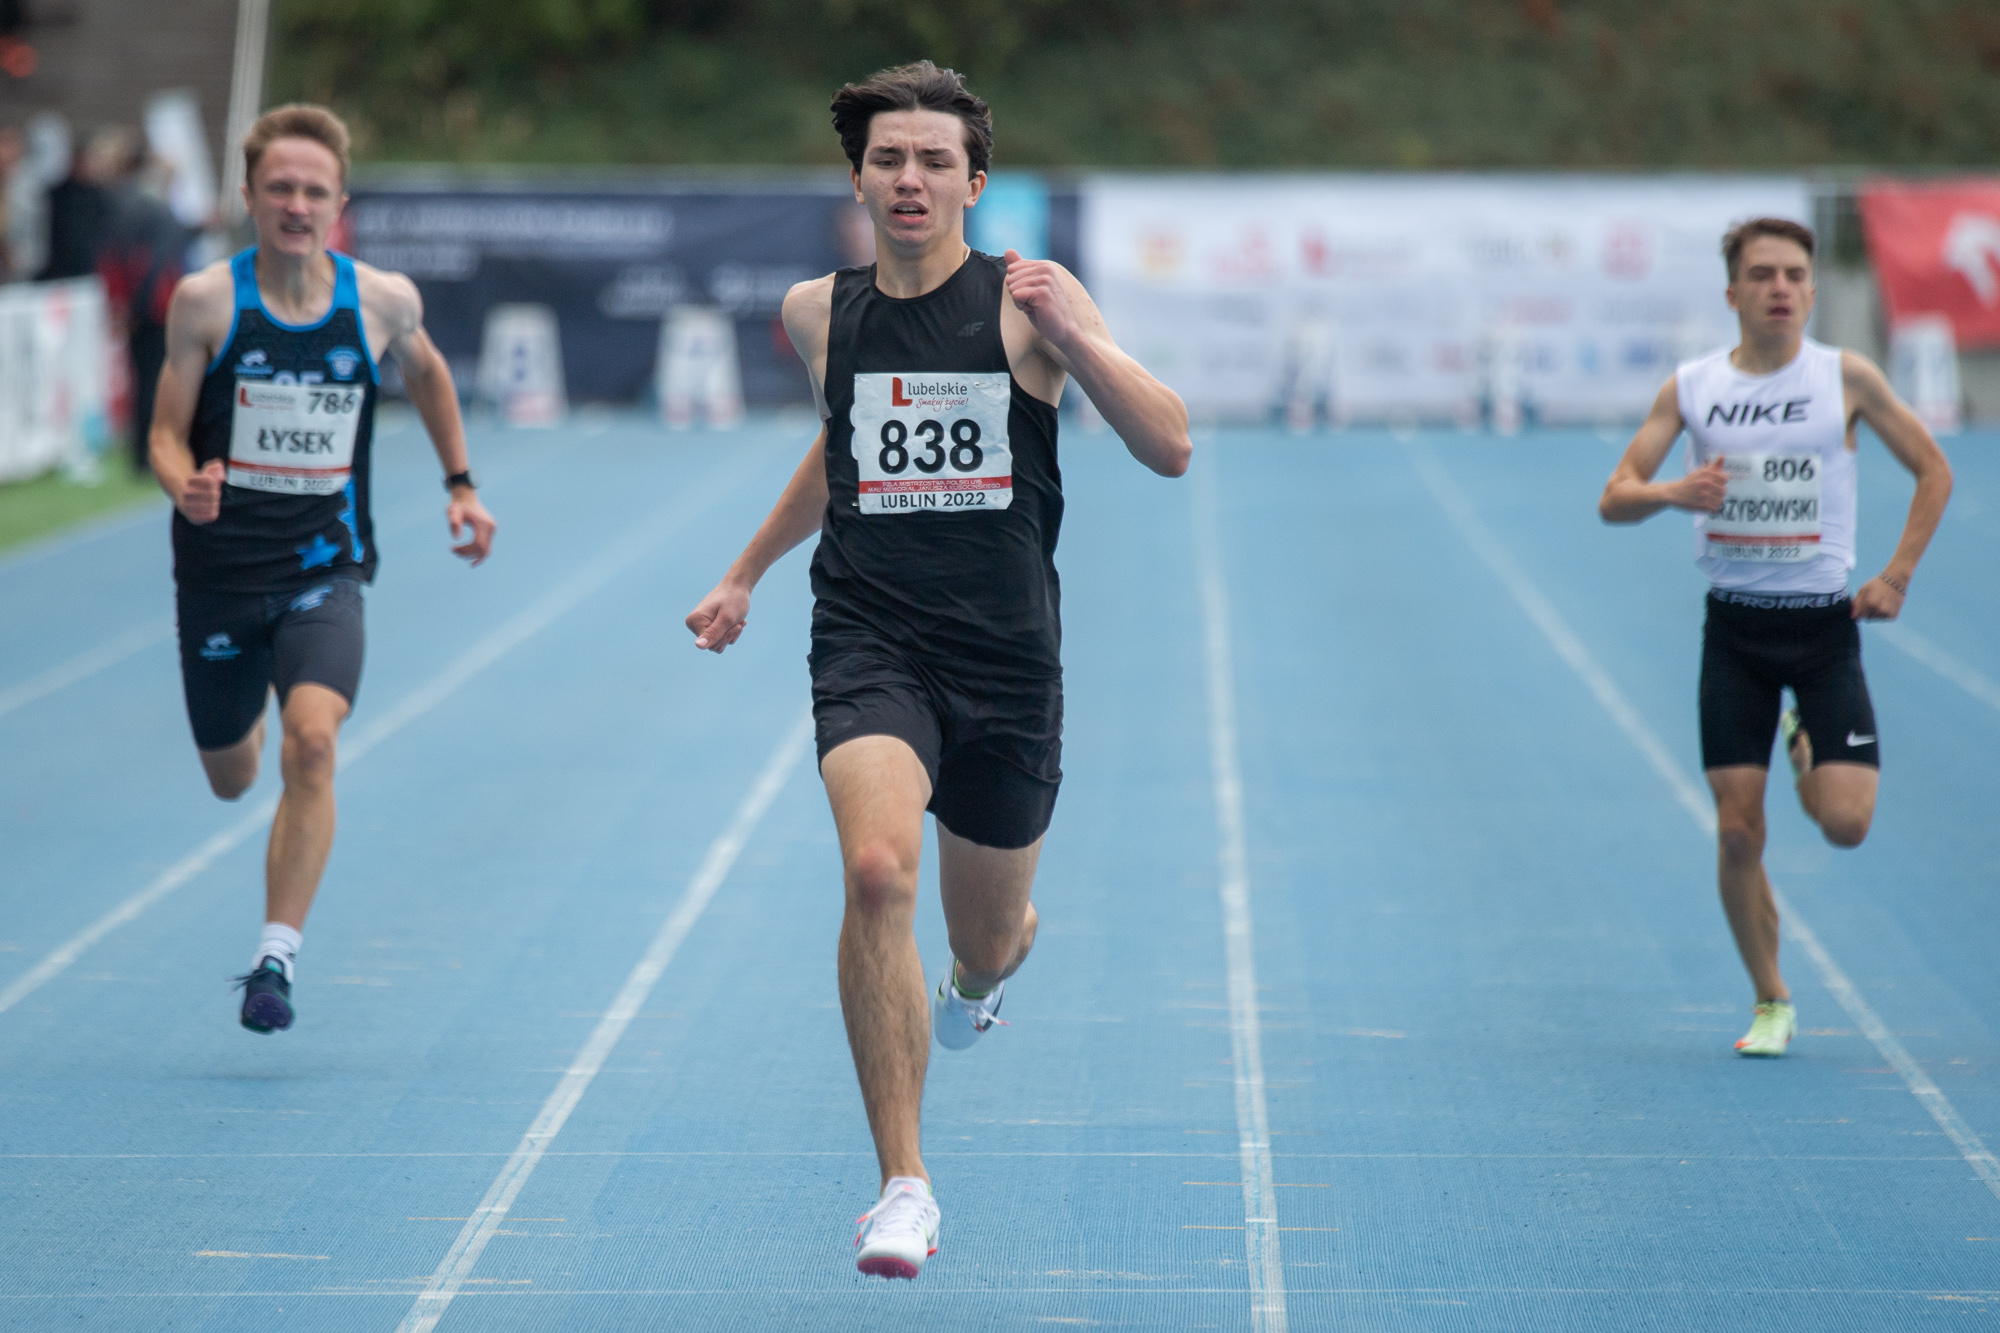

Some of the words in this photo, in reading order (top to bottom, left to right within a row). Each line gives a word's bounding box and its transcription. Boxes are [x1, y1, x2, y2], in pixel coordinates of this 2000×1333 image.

[907, 382, 968, 396] lubelskie
[308, 391, 355, 415] 786
[915, 397, 944, 413] Smakuj
[944, 397, 970, 411] życie!
[1706, 397, 1812, 427] NIKE
[257, 428, 336, 455] ŁYSEK
[879, 418, 984, 475] 838
[1763, 459, 1815, 482] 806
[881, 493, 936, 509] LUBLIN
[943, 492, 986, 507] 2022
[1708, 498, 1818, 521] RZYBOWSKI
